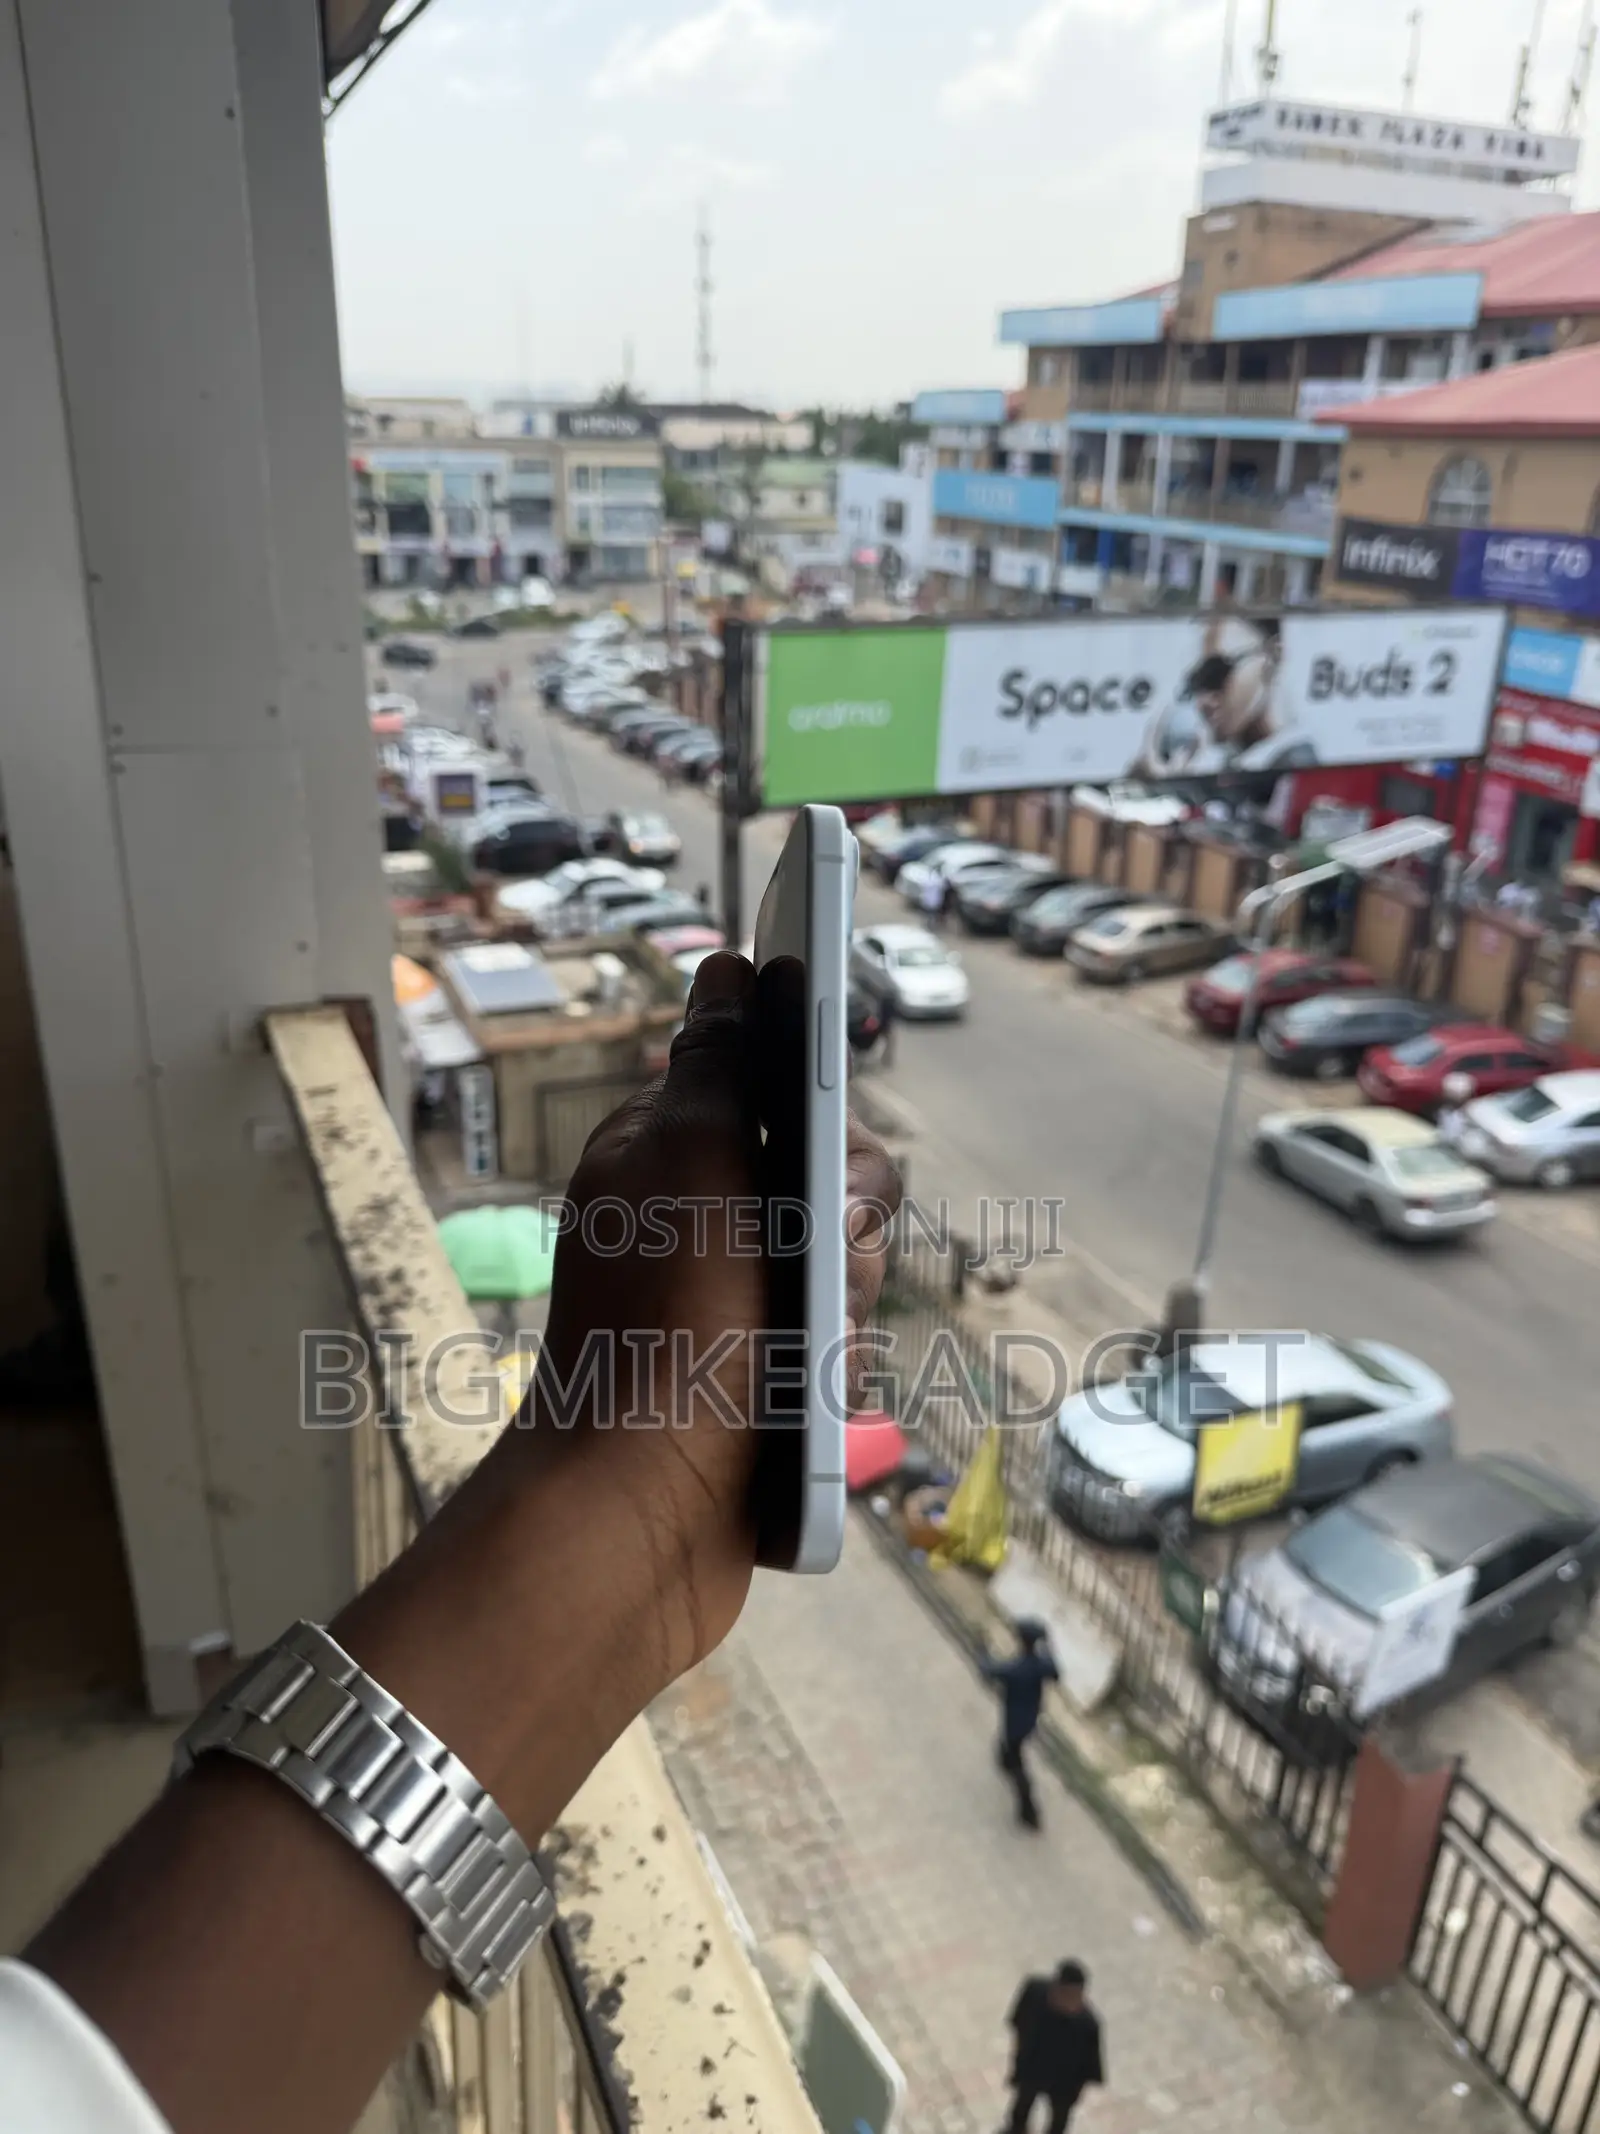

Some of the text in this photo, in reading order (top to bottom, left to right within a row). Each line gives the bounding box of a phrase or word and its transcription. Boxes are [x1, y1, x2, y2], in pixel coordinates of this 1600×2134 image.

[1342, 534, 1442, 580] Infinix
[998, 669, 1154, 731] Space
[1309, 648, 1415, 701] Buds
[1424, 650, 1458, 695] 2
